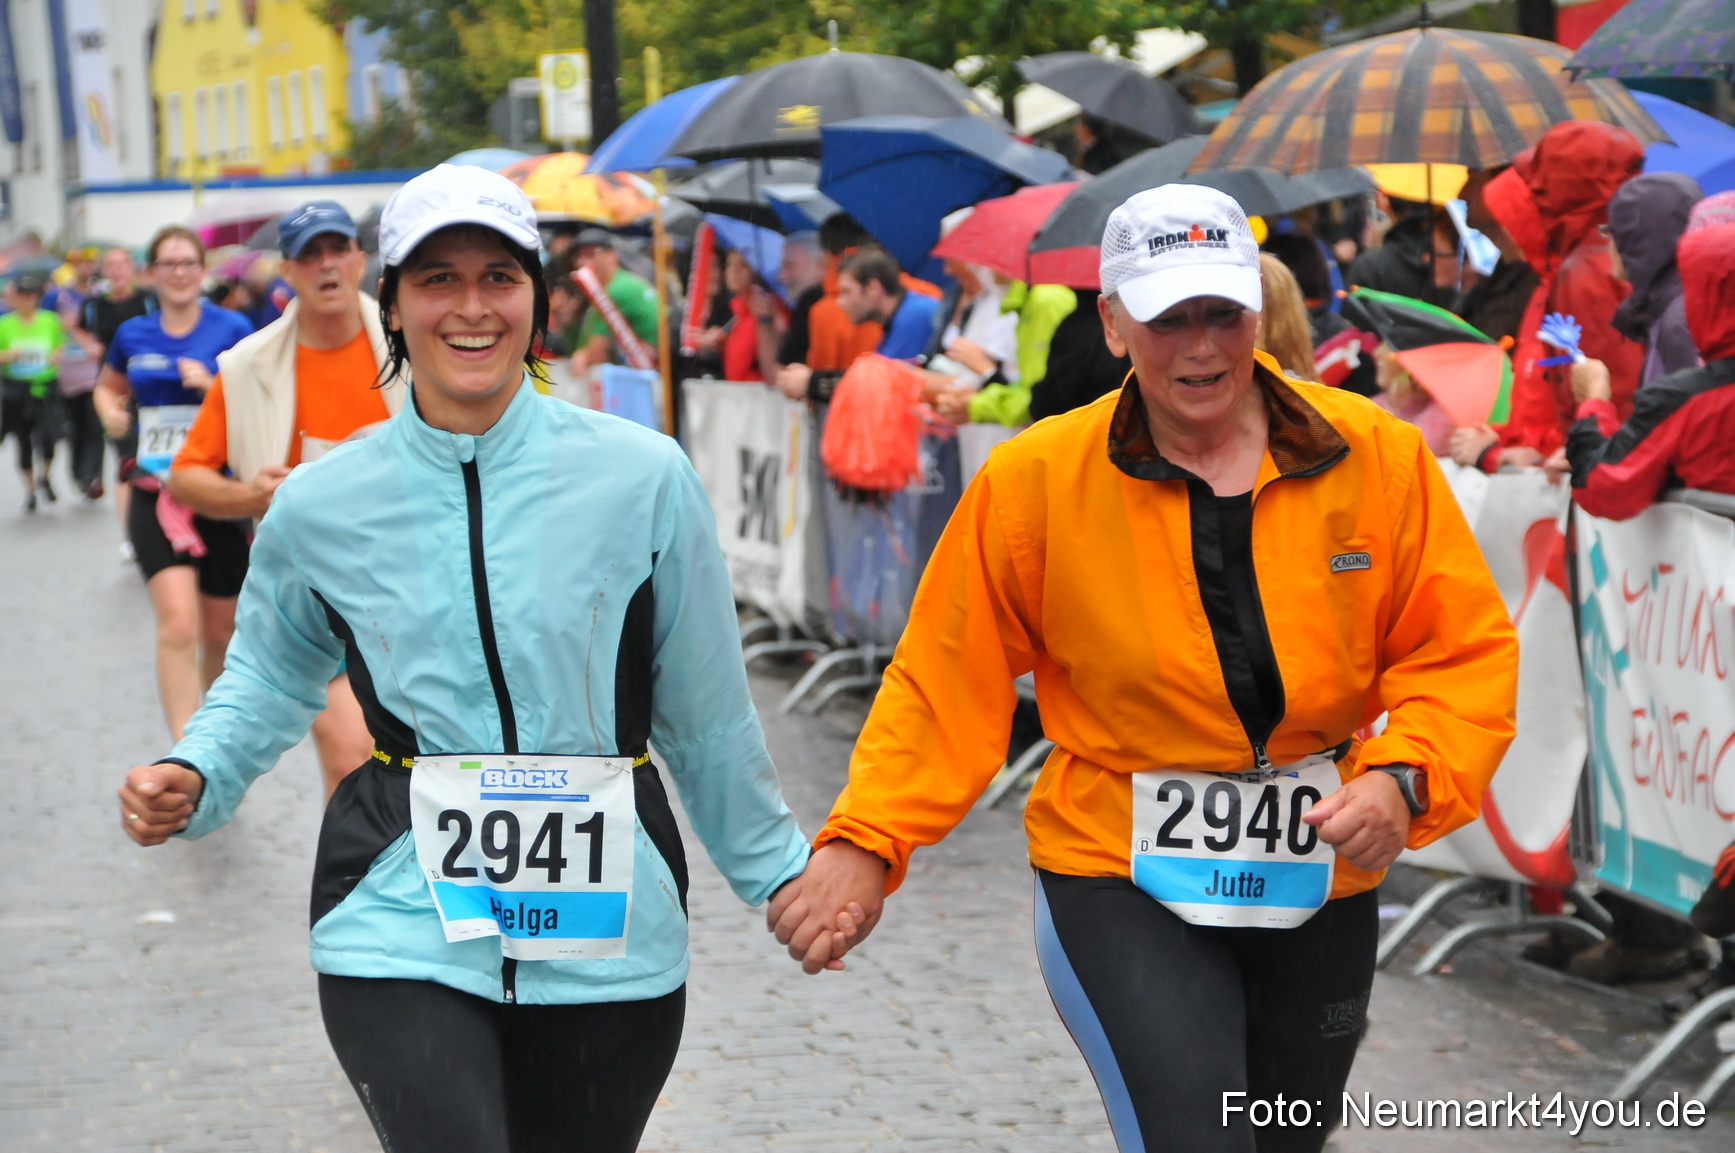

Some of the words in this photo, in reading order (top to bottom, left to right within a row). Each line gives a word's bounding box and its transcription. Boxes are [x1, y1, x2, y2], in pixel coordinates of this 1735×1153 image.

[477, 195, 522, 217] 2XU
[1148, 223, 1229, 250] IRONMAN
[1150, 243, 1195, 258] ACTIVE
[480, 769, 568, 788] BOCK
[1156, 779, 1322, 856] 2940
[437, 809, 605, 884] 2941
[1205, 869, 1266, 898] Jutta
[490, 896, 558, 937] Helga
